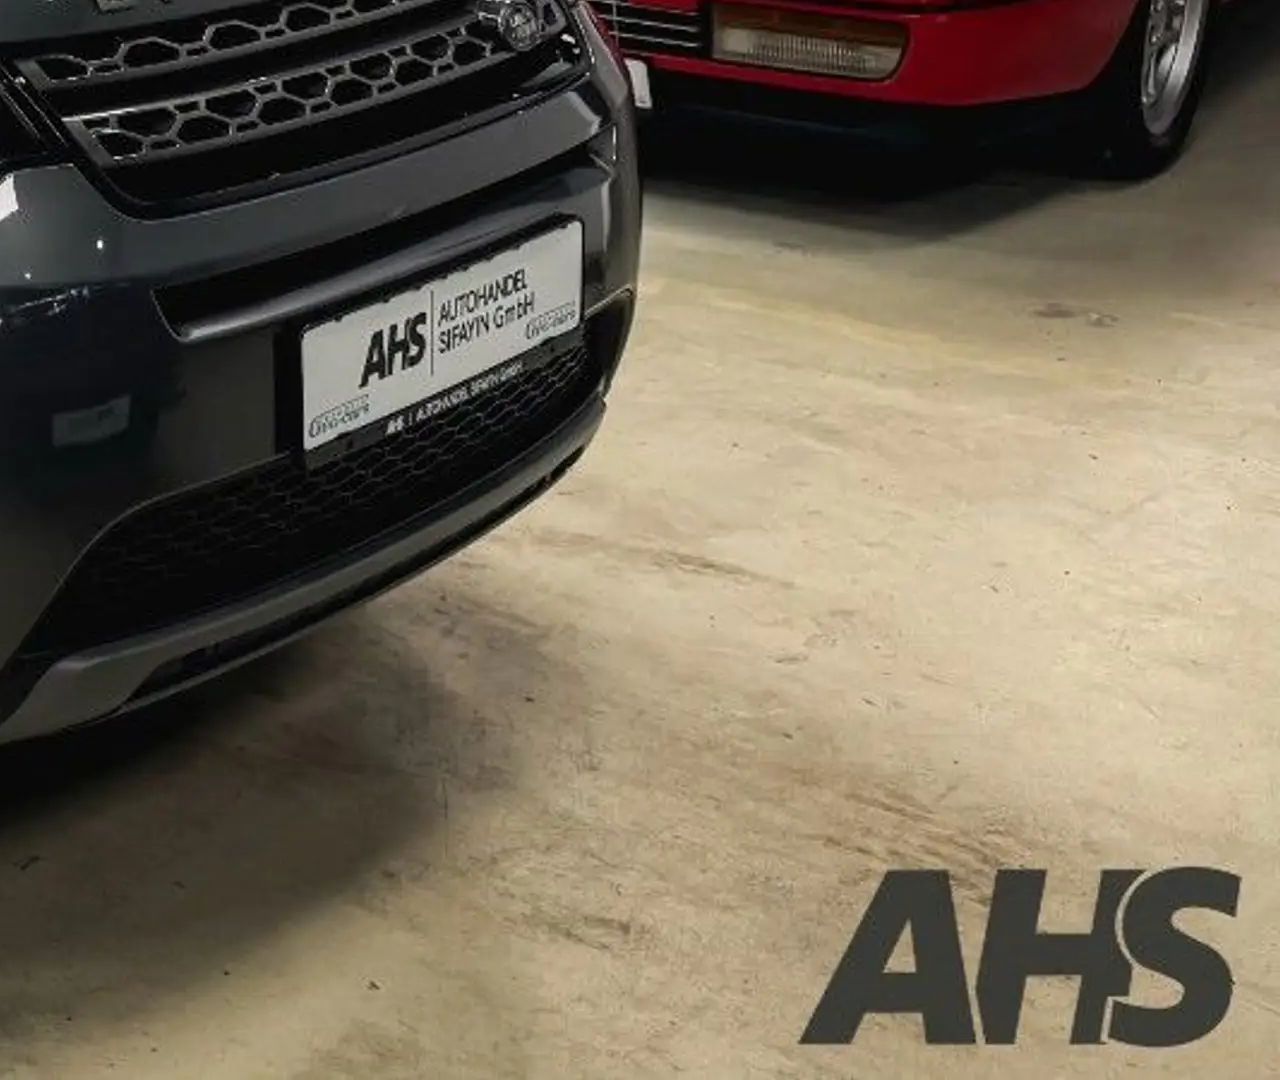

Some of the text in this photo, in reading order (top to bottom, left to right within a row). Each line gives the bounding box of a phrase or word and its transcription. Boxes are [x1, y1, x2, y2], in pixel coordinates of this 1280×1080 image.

[438, 267, 528, 323] AUTOHANDEL
[438, 312, 491, 354] SIFAYIN
[495, 290, 537, 330] GmbH
[358, 311, 428, 389] AHS
